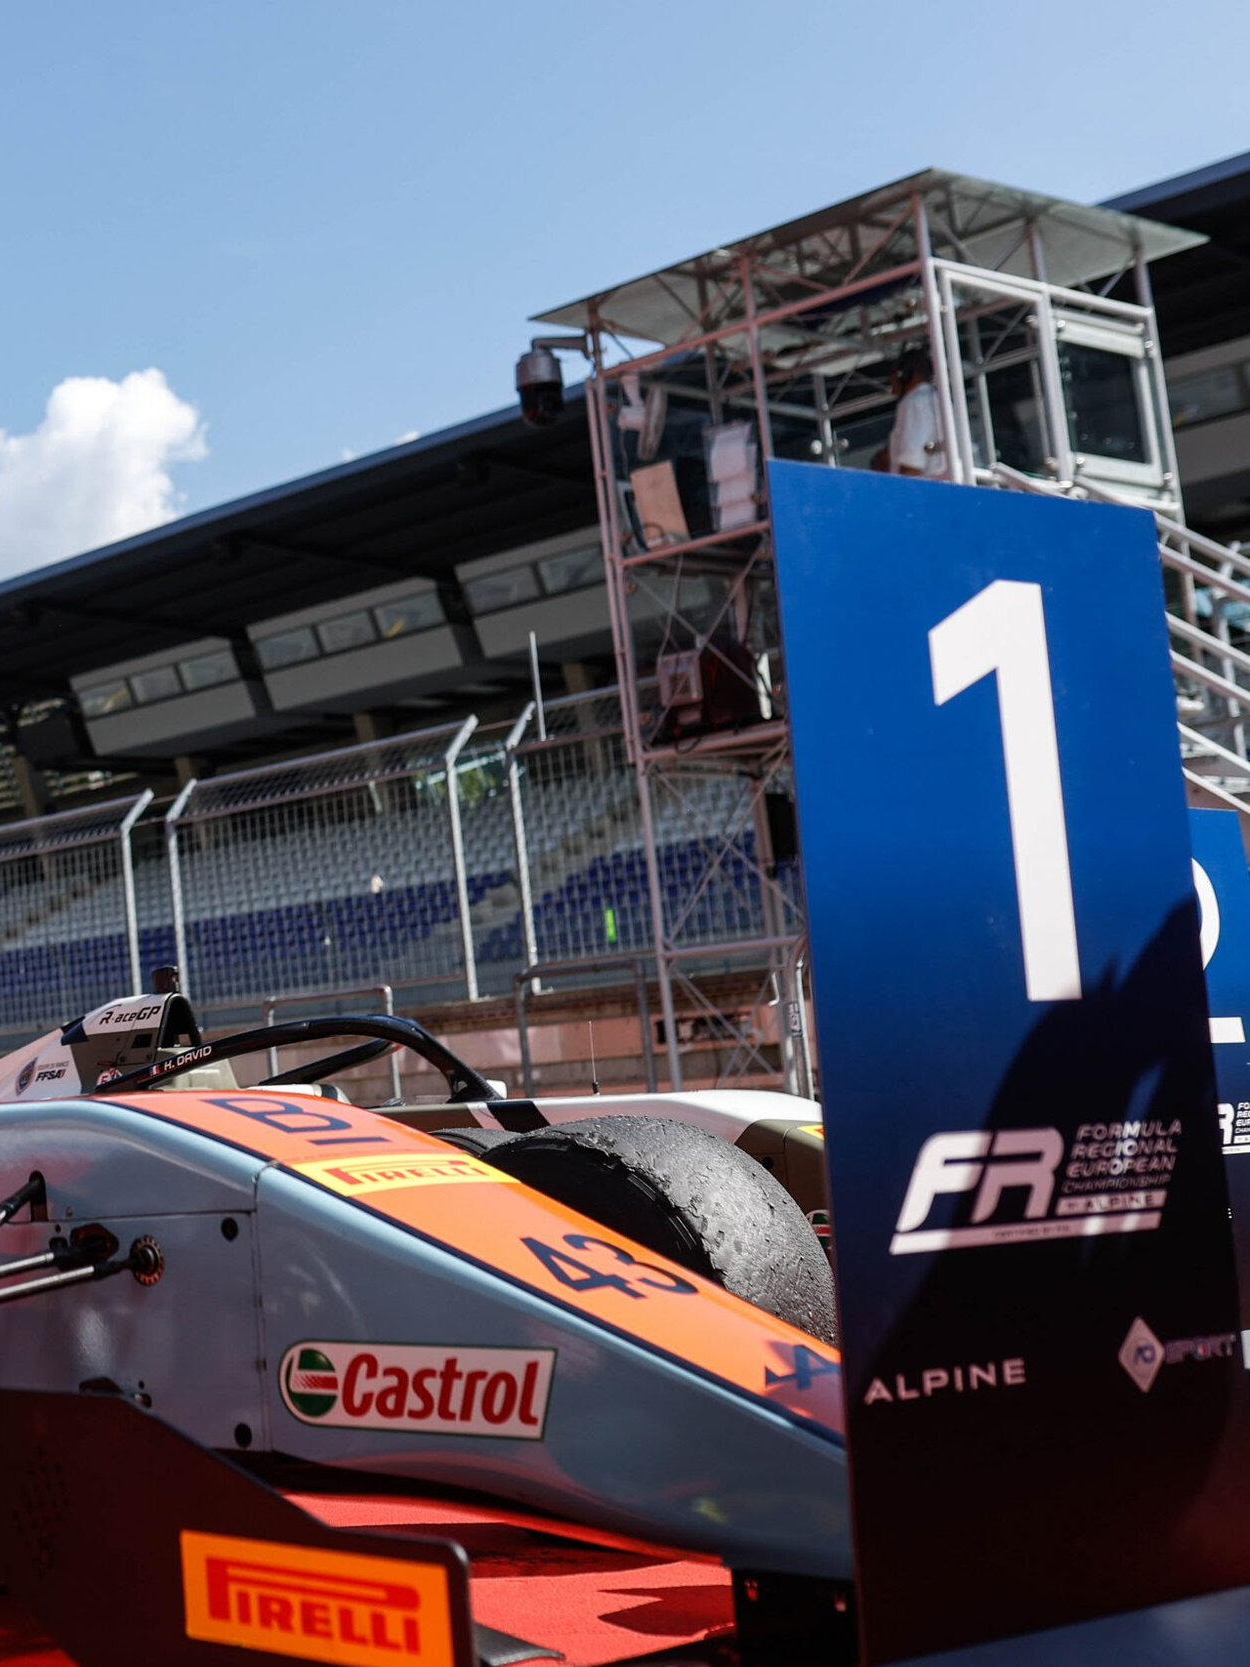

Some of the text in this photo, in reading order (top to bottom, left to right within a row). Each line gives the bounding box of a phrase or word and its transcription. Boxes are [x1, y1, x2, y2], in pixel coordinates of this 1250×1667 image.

[928, 579, 1082, 1001] 1
[164, 1045, 213, 1071] H. DAVID
[35, 1069, 63, 1082] FFSA
[1076, 1118, 1182, 1140] FORMULA
[1071, 1138, 1178, 1160] REGIONAL
[323, 1159, 488, 1186] PIRELLI
[894, 1126, 1065, 1233] FR
[1066, 1155, 1176, 1179] EUROPEAN
[1061, 1173, 1171, 1194] CHAMPIONSHIP
[1087, 1193, 1154, 1211] ALPINE
[520, 1234, 699, 1299] 43
[342, 1353, 539, 1426] Castrol
[864, 1358, 1026, 1406] ALPINE
[205, 1557, 421, 1656] PIRELLI
